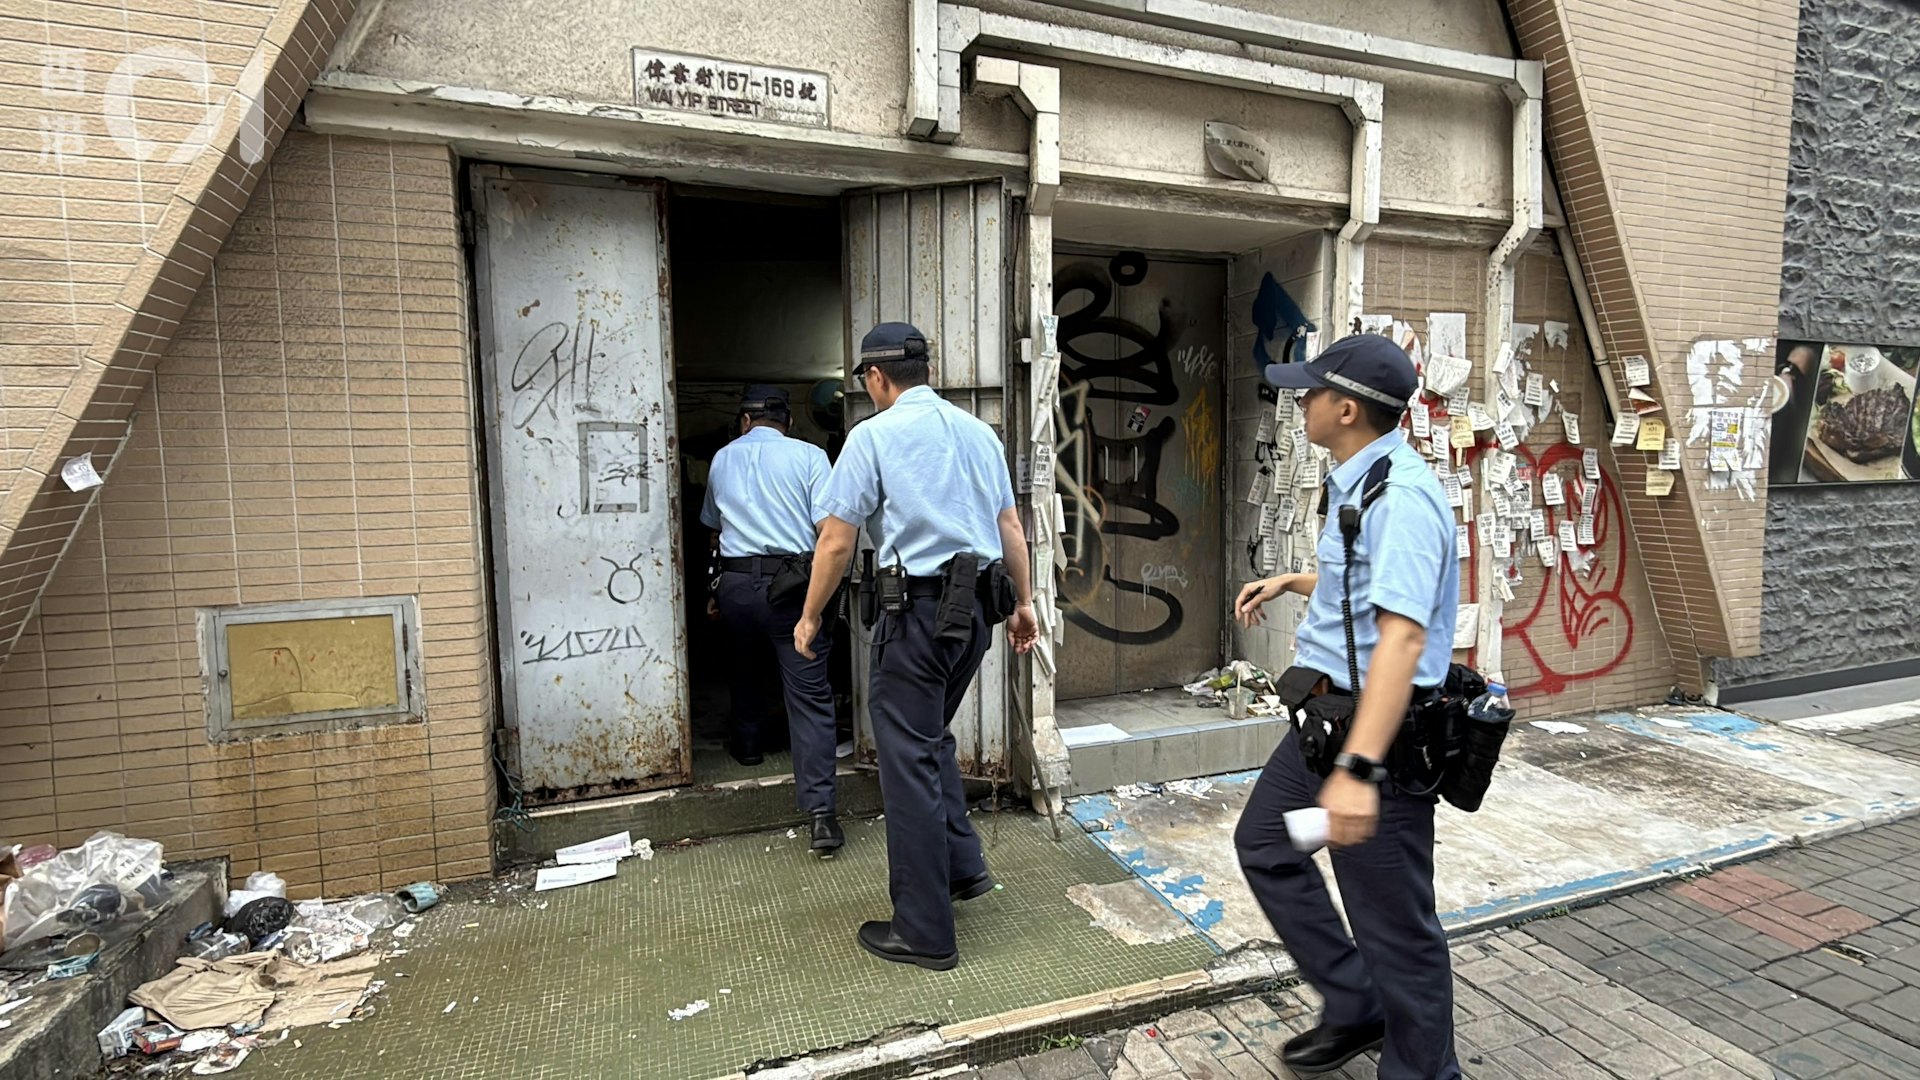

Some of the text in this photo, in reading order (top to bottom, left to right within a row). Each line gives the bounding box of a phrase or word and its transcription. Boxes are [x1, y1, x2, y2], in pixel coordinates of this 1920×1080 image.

[646, 86, 761, 117] WAI YIP STREET
